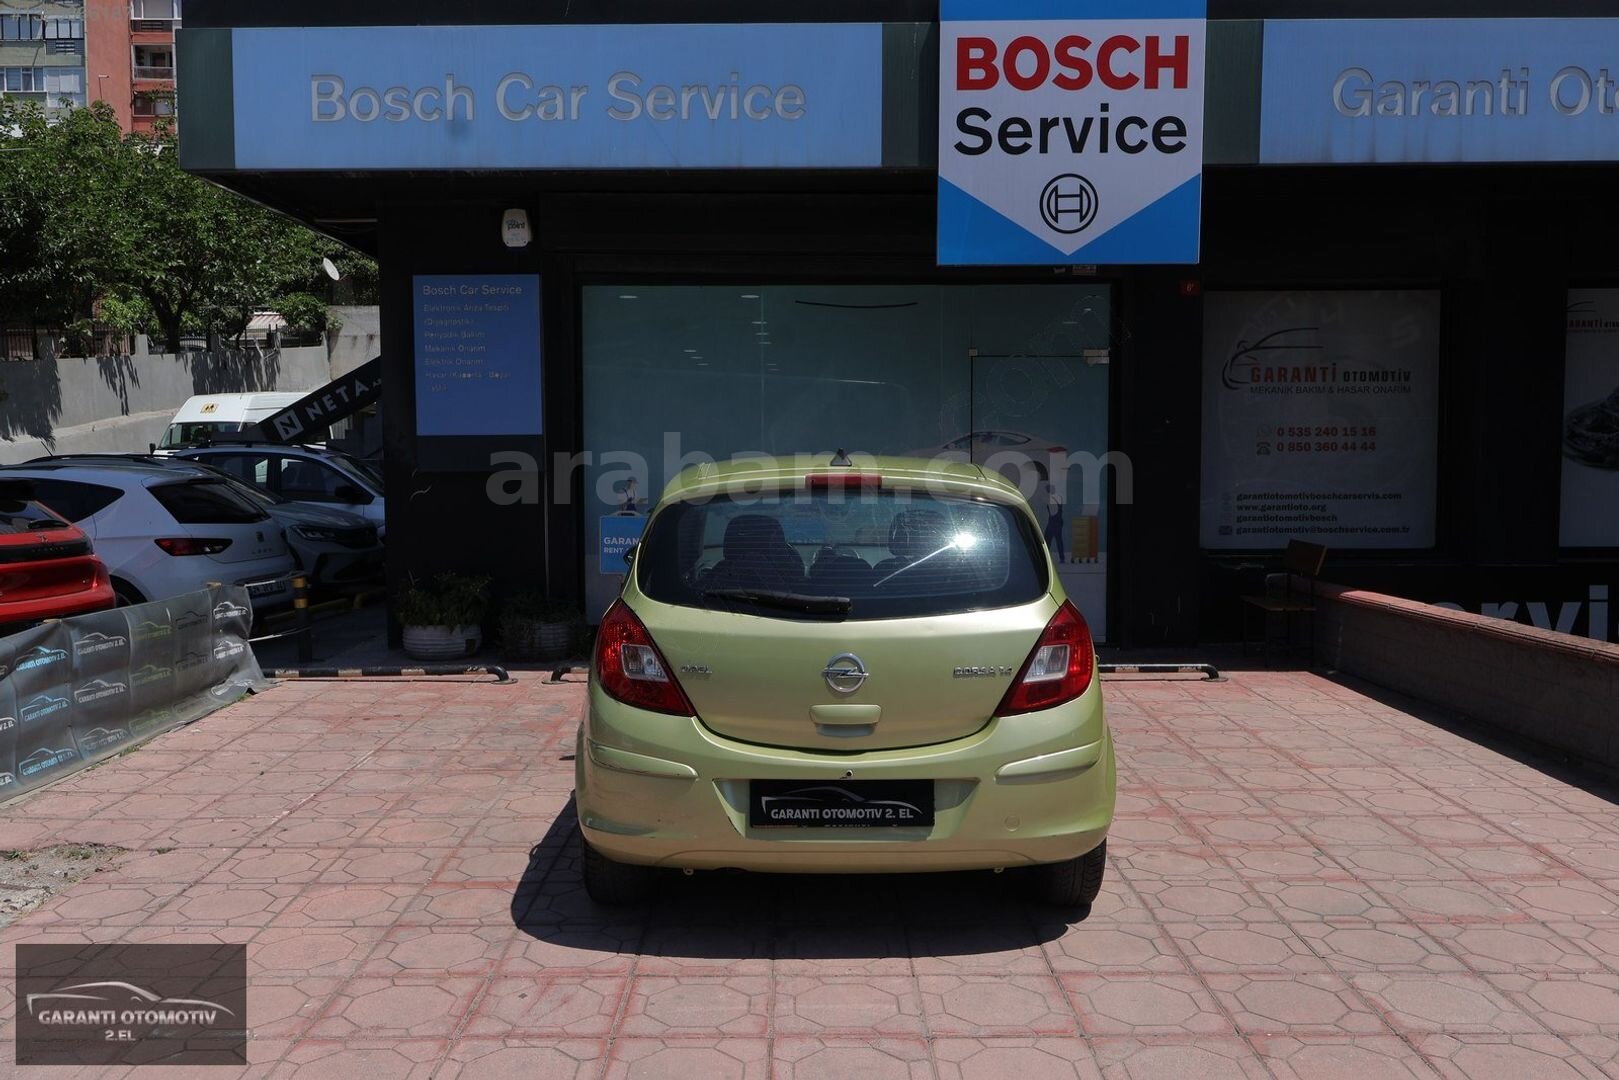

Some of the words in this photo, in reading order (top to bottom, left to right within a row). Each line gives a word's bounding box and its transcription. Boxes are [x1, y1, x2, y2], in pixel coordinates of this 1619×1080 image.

[956, 35, 1189, 91] BOSCH
[310, 73, 475, 122] Bosch
[496, 71, 588, 122] Car
[607, 70, 806, 121] Service
[1333, 66, 1529, 117] Garanti
[1550, 65, 1619, 117] Ot
[954, 102, 1188, 156] Service
[423, 285, 456, 296] Bosch
[460, 285, 478, 295] Car
[481, 284, 522, 295] Service
[1337, 385, 1370, 394] HASAR
[304, 378, 370, 421] NETA
[1277, 427, 1284, 436] 0
[1288, 427, 1311, 436] 535
[1315, 427, 1338, 436] 240
[1342, 427, 1357, 436] 15
[1277, 442, 1284, 452] 0
[1315, 442, 1338, 452] 360
[1342, 442, 1357, 452] 44
[1361, 442, 1376, 452] 44
[603, 537, 640, 545] GARAN
[770, 808, 820, 819] GARANTI
[822, 808, 882, 819] OTOMOTIV
[885, 808, 896, 819] 2.
[898, 808, 914, 819] EL
